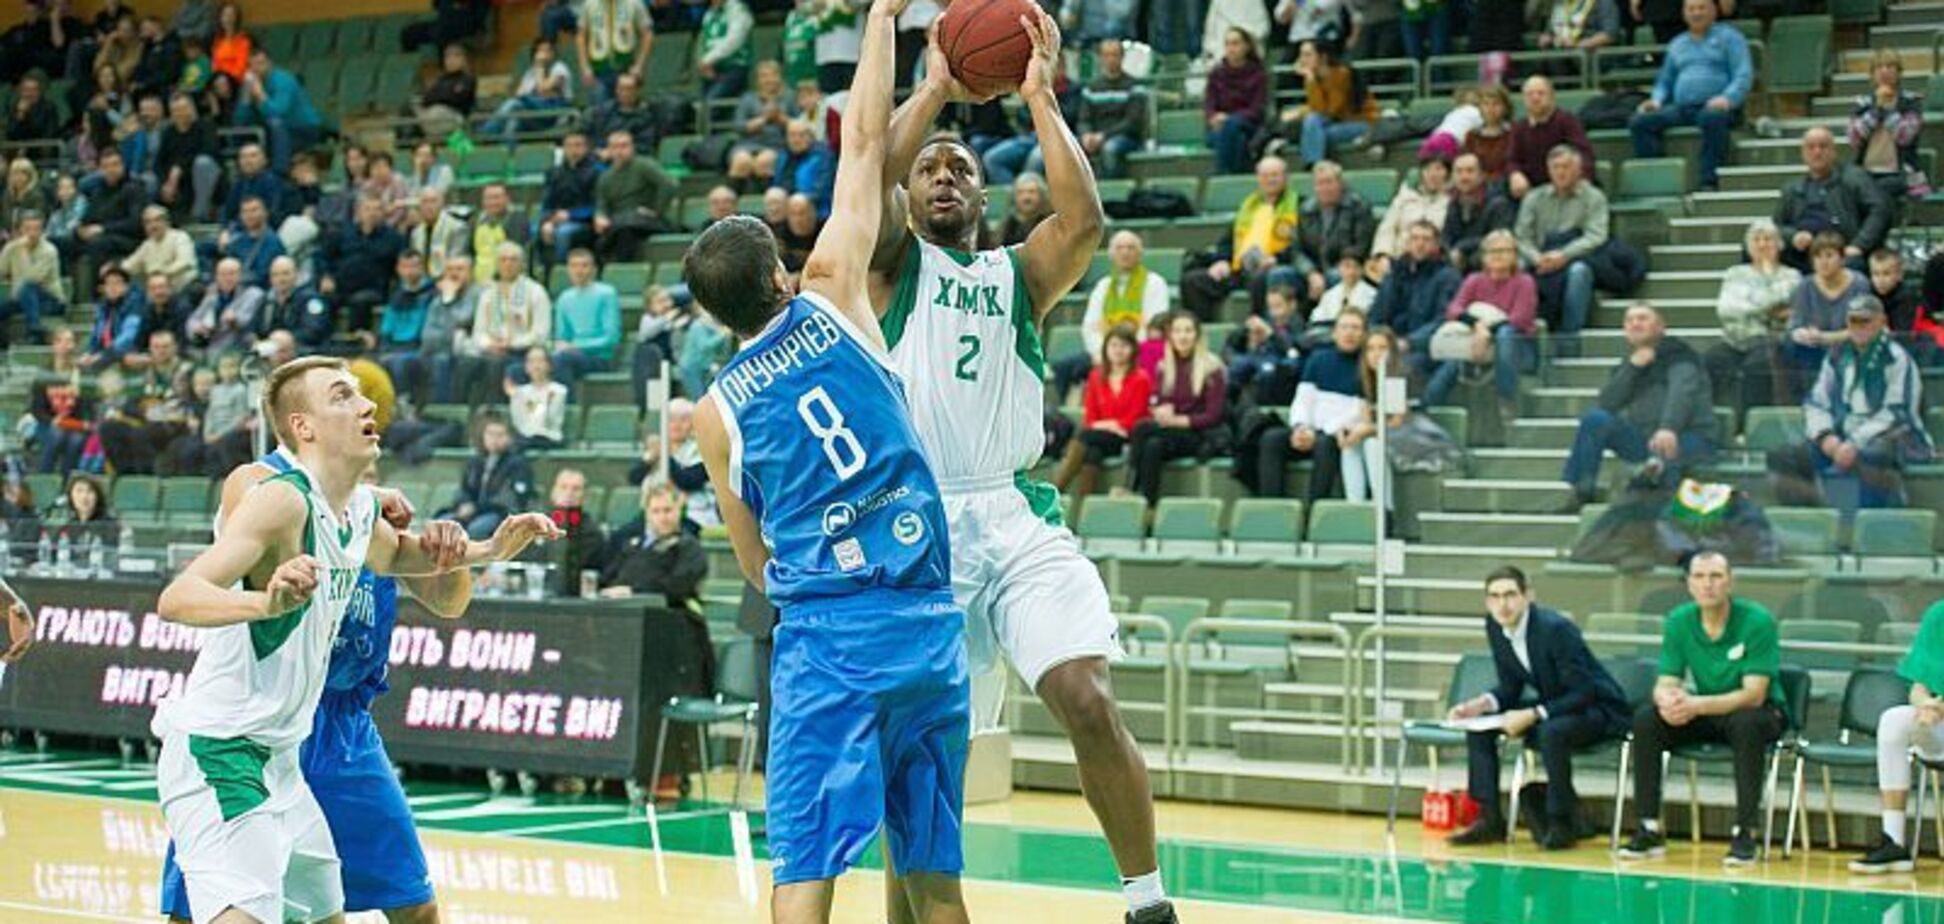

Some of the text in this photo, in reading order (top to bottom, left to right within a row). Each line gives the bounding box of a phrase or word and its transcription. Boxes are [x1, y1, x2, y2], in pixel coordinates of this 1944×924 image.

[721, 311, 840, 407] ОНУФРІЄВ
[955, 334, 980, 381] 2
[797, 385, 867, 482] 8
[35, 606, 135, 647] ГРАЮТЬ
[449, 629, 536, 672] ВОНИ
[564, 696, 622, 740] ВИ!
